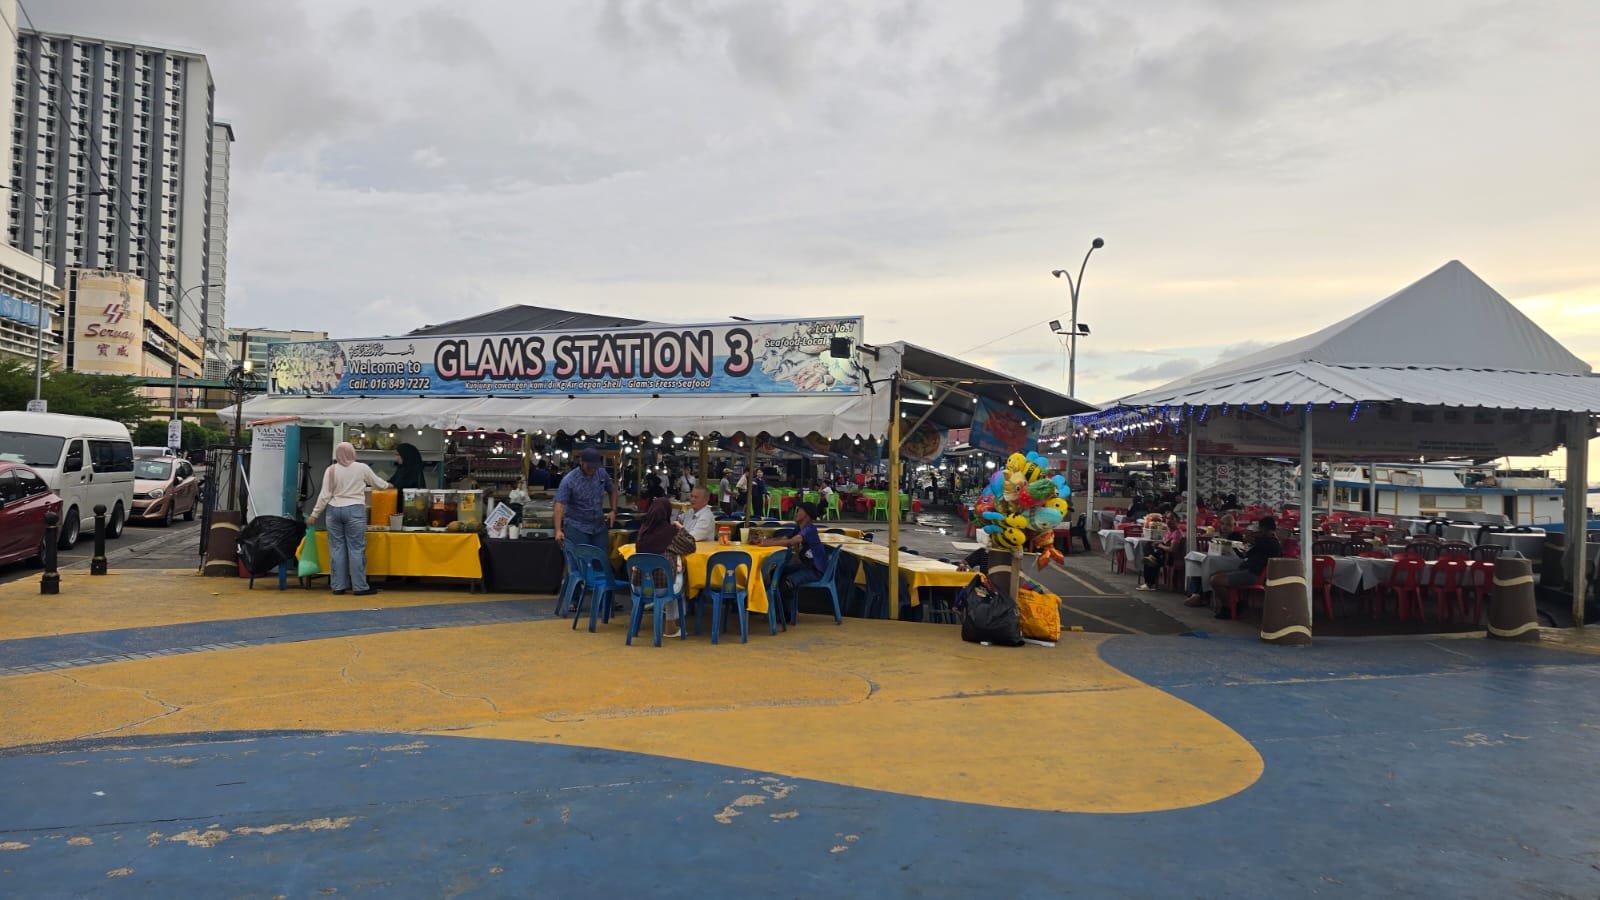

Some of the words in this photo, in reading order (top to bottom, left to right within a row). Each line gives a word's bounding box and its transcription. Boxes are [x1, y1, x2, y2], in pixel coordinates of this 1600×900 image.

[84, 323, 136, 344] Servay
[815, 324, 831, 333] Lot
[435, 339, 544, 379] GLAMS
[554, 328, 711, 378] STATION
[725, 330, 752, 376] 3
[348, 360, 404, 375] Welcome
[407, 361, 421, 374] to
[348, 378, 369, 390] Call:
[370, 378, 388, 390] 016
[388, 378, 406, 390] 849
[407, 378, 431, 389] 7272
[602, 380, 622, 389] Shell
